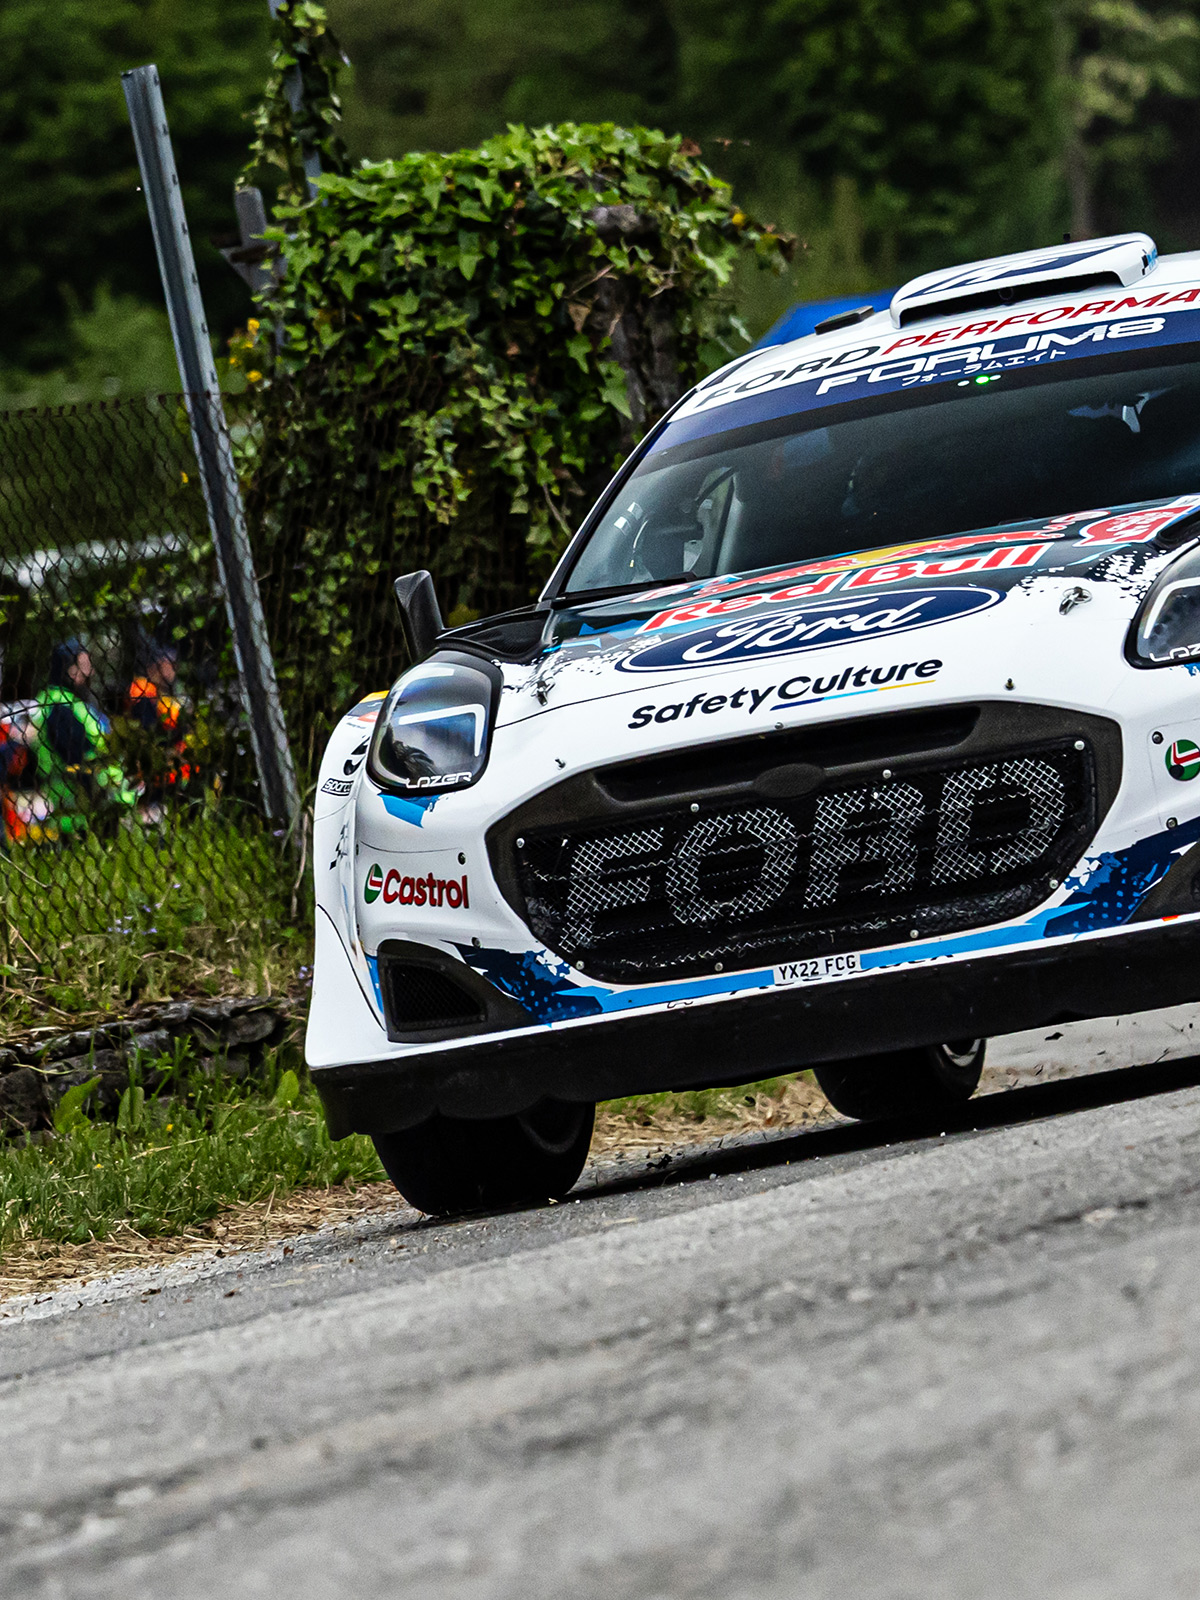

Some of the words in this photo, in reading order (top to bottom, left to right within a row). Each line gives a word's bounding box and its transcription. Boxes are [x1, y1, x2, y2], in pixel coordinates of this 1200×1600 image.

[694, 346, 881, 409] FORD
[815, 316, 1165, 396] FORUM8
[901, 349, 1067, 387] フォーラムエイト
[636, 571, 851, 635] Red
[841, 542, 1054, 590] Bull
[676, 592, 937, 662] Ford
[626, 656, 944, 730] SafetyCulture
[405, 771, 473, 789] LAZER
[382, 868, 470, 909] Castrol
[558, 758, 1067, 954] FORD
[779, 961, 819, 981] YX22
[825, 954, 857, 974] FCG
